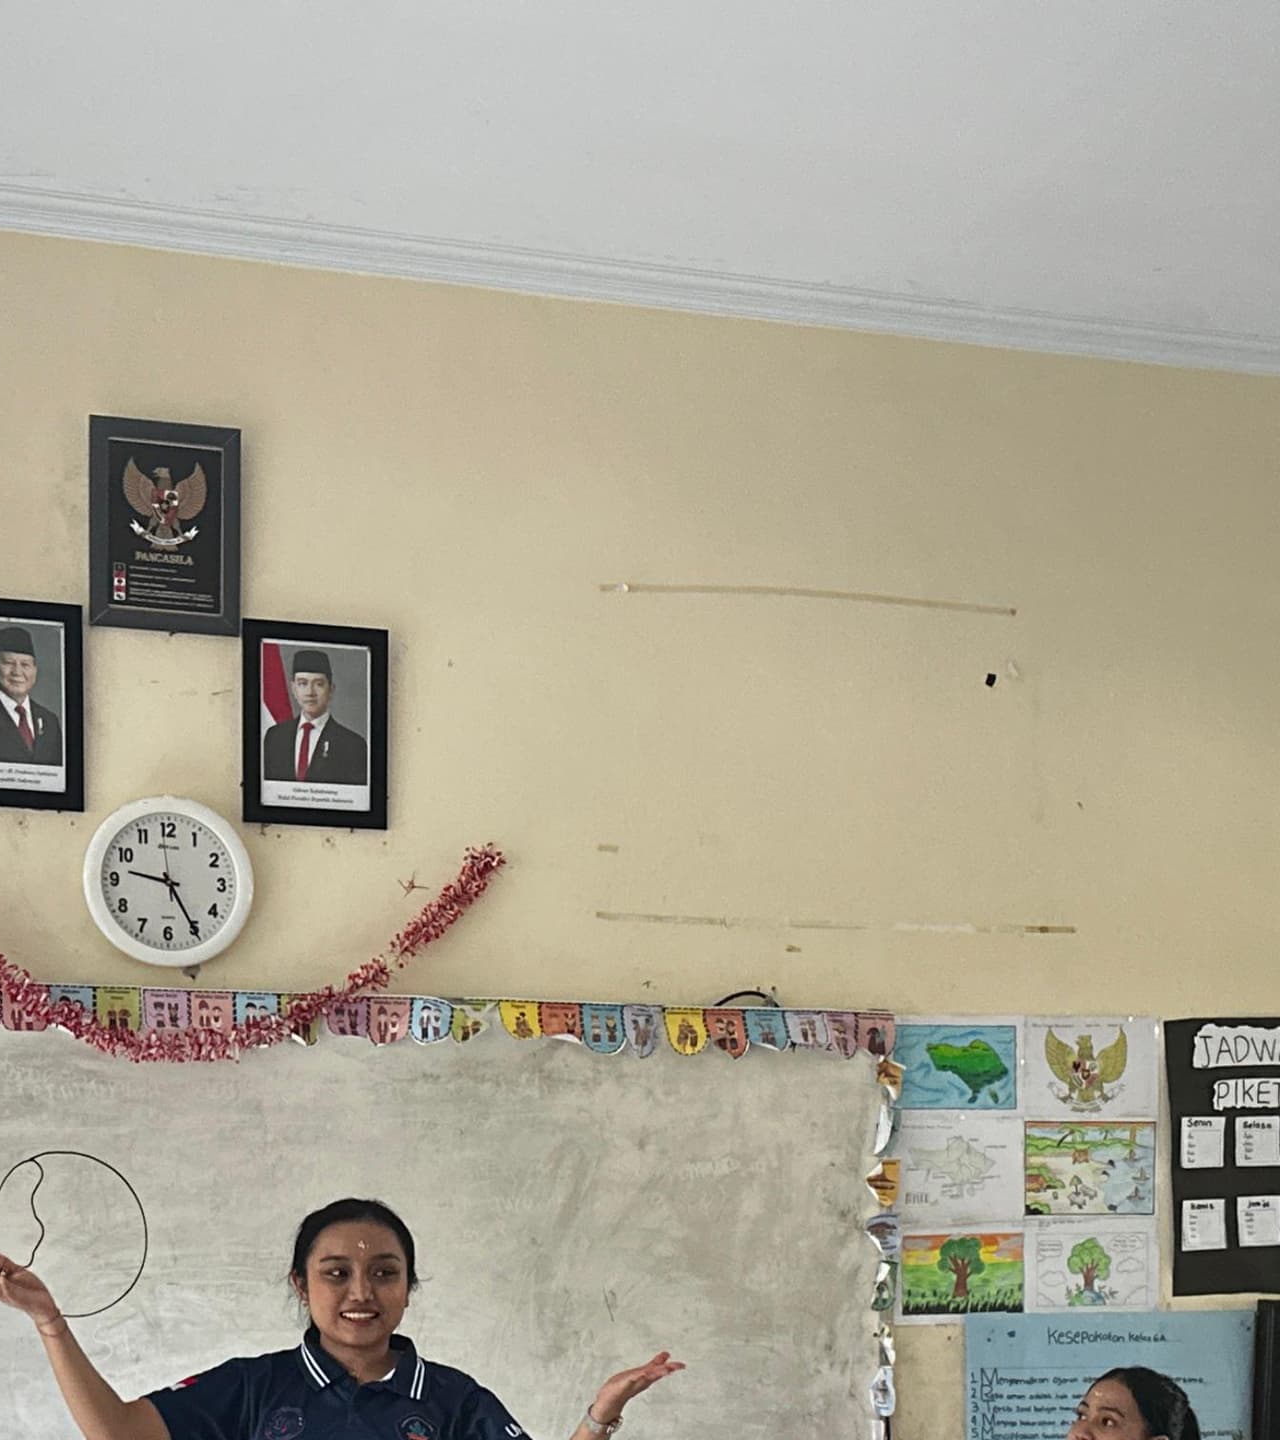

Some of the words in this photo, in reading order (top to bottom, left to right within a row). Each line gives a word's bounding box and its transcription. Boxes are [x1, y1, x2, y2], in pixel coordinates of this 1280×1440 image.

[135, 552, 194, 566] PANCASILA
[138, 829, 148, 844] 11
[160, 823, 176, 838] 12
[192, 832, 197, 847] 1
[119, 848, 133, 862] 10
[209, 853, 219, 867] 2
[110, 872, 119, 886] 9
[217, 878, 226, 892] 3
[118, 898, 128, 913] 8
[208, 903, 218, 918] 4
[138, 918, 148, 933] 7
[163, 926, 173, 941] 6
